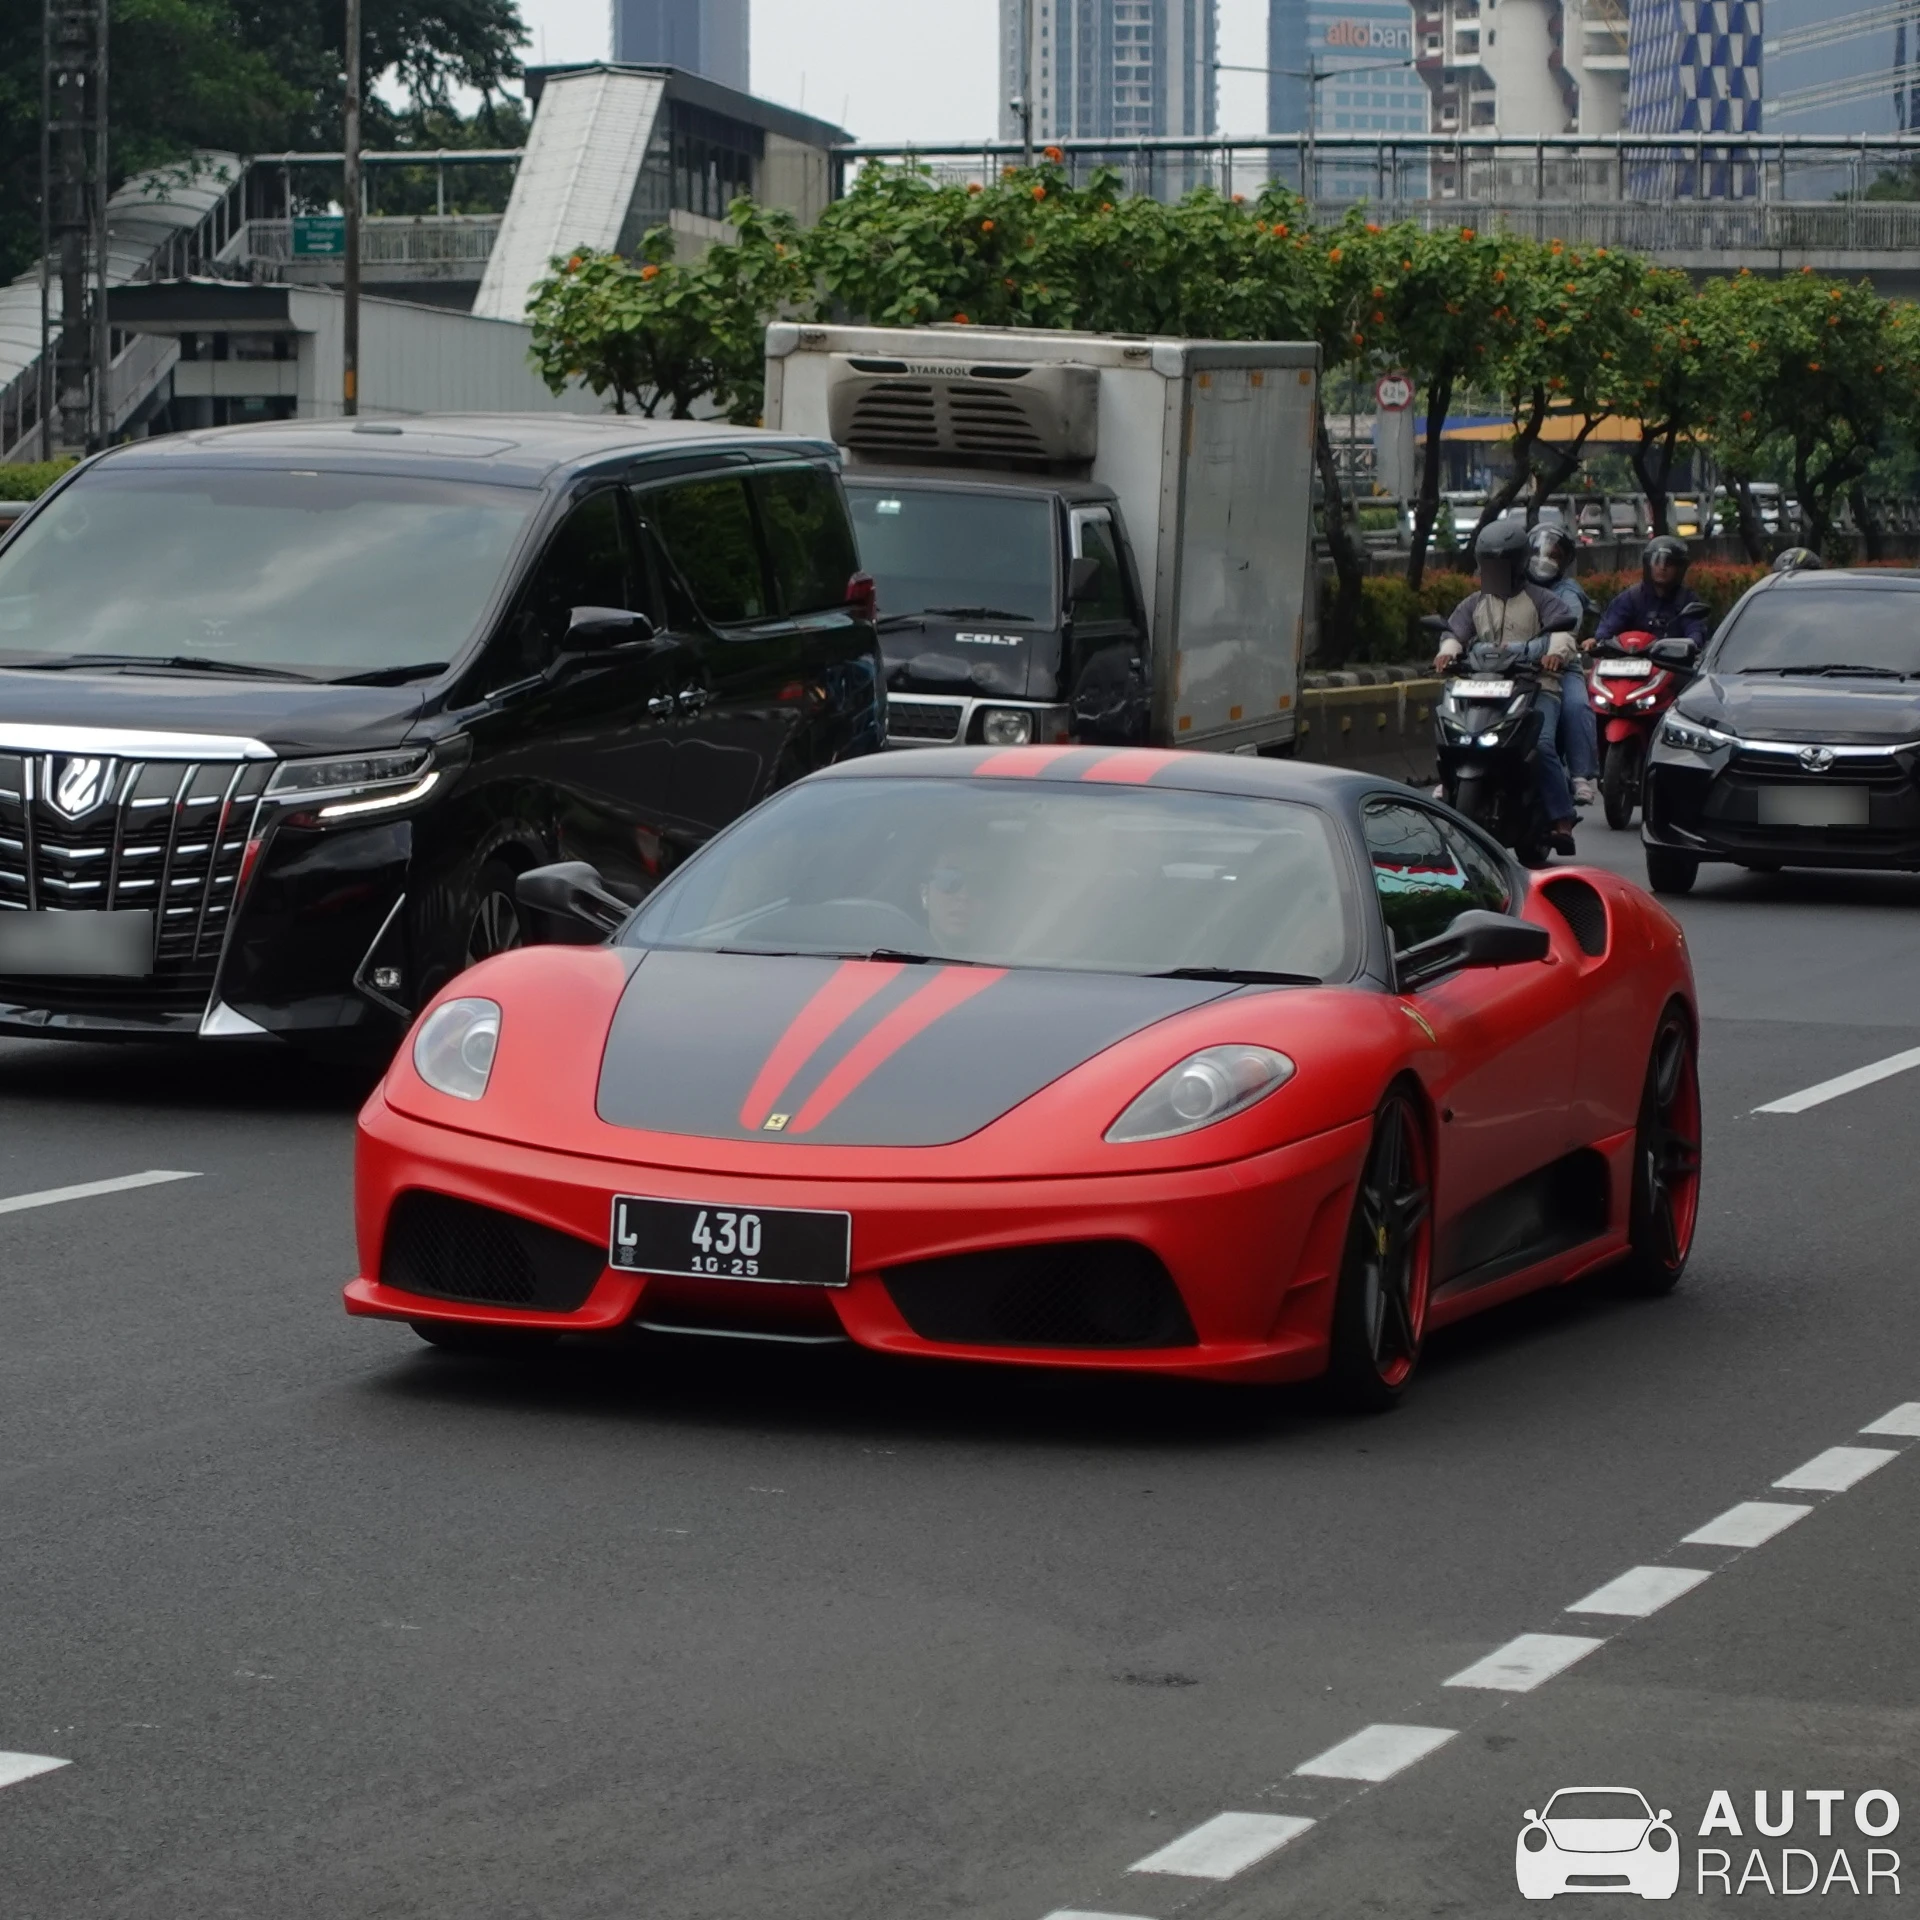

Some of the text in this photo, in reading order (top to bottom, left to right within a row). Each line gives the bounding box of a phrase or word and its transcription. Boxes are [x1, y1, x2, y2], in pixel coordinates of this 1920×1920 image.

[909, 365, 968, 376] STARKOOL
[955, 632, 1024, 646] COLT
[617, 1203, 762, 1256] L 430
